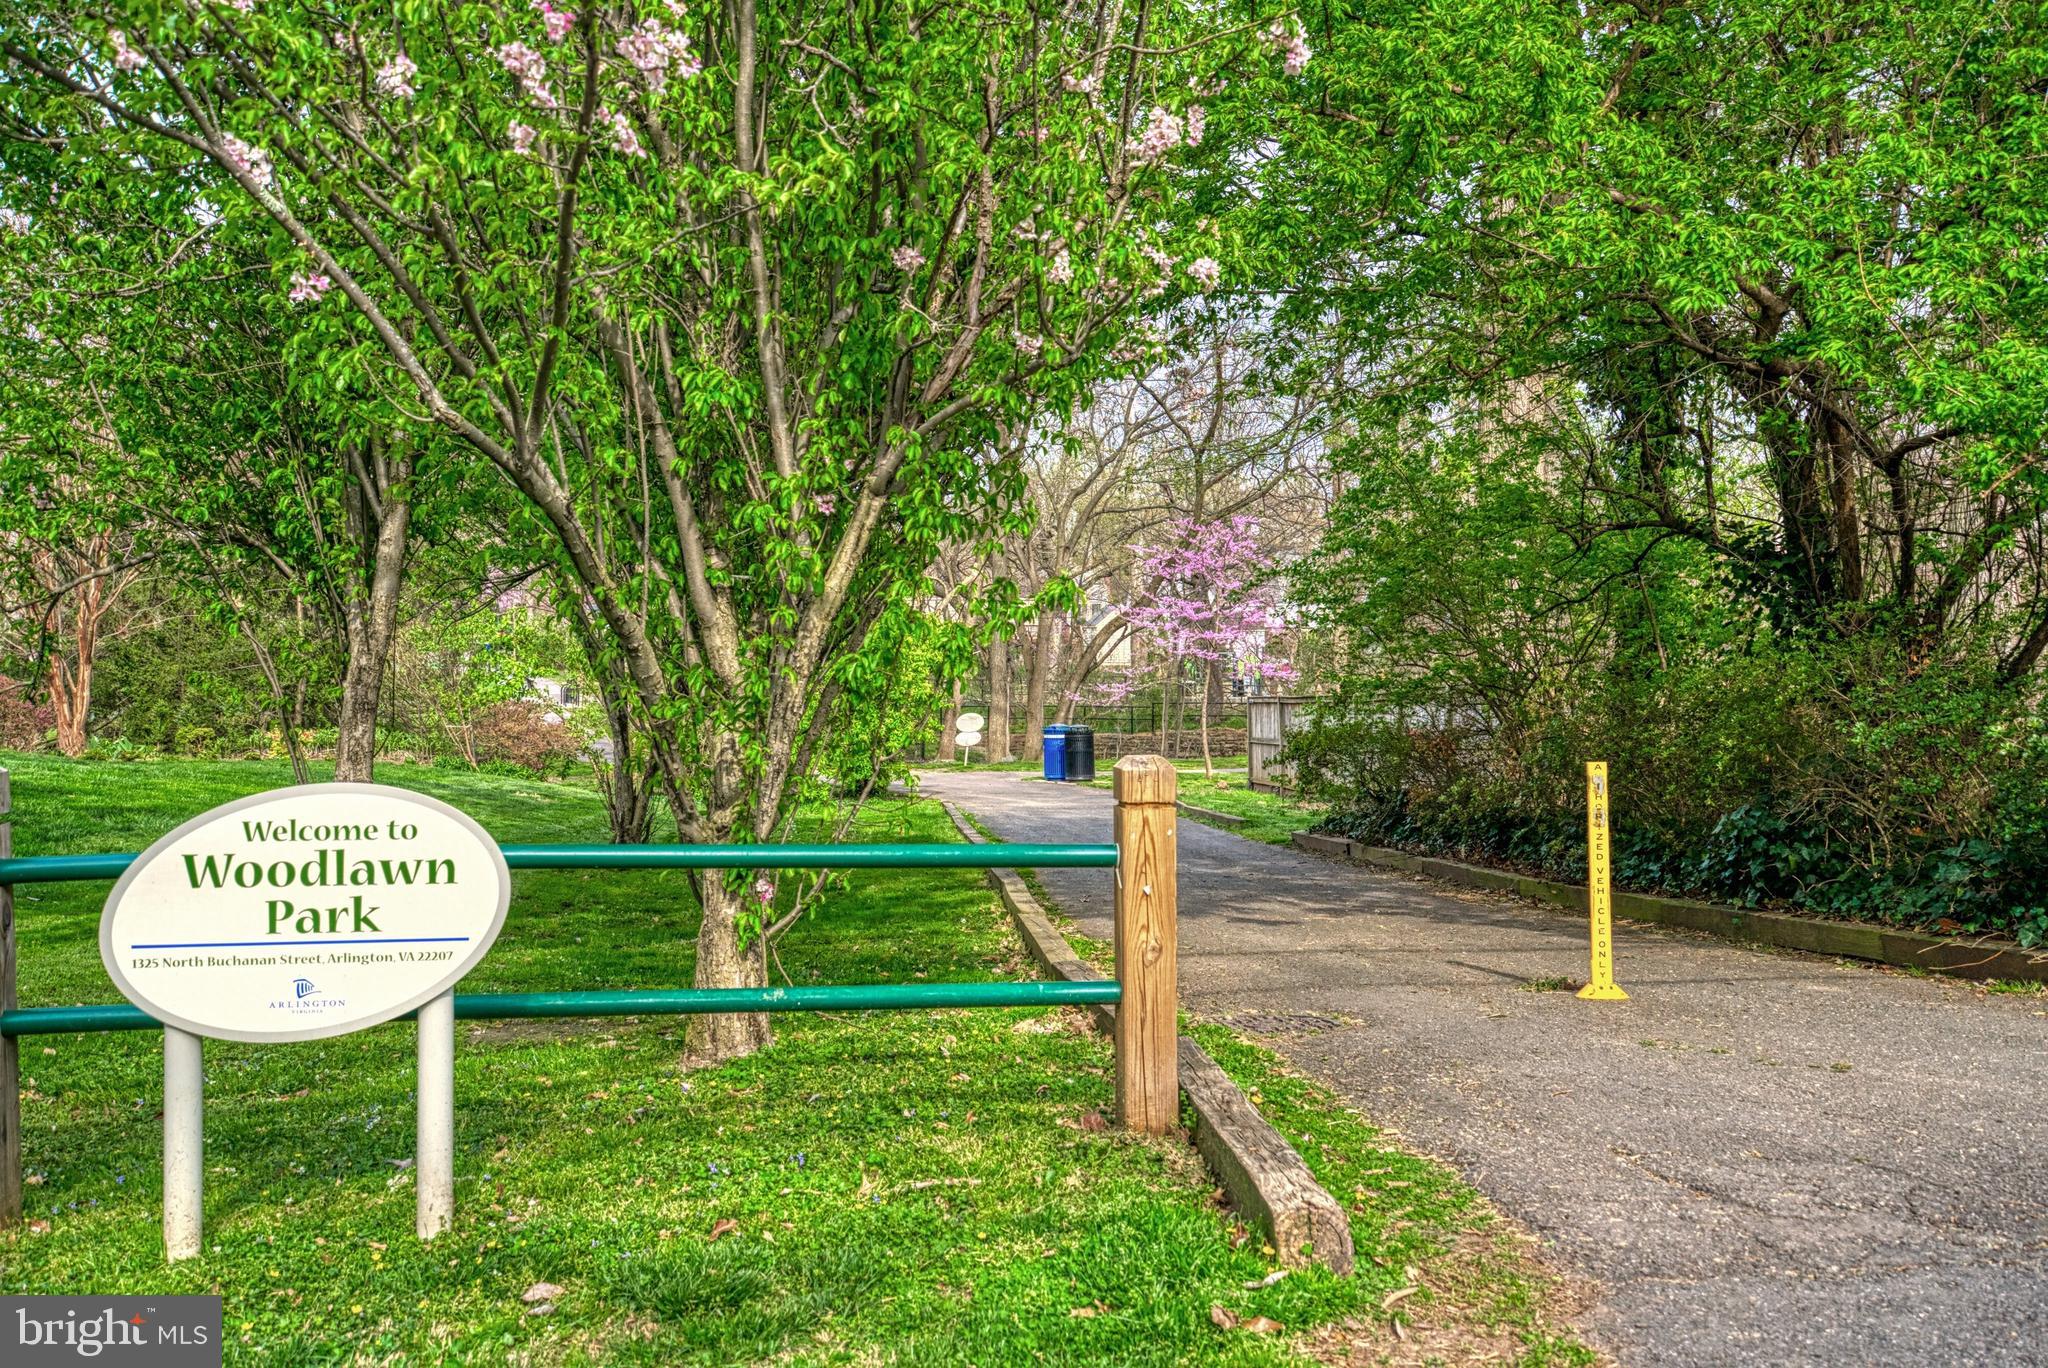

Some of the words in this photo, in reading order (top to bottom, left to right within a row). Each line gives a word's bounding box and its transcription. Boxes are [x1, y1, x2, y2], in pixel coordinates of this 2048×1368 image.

[242, 818, 378, 842] Welcome
[388, 820, 418, 841] to
[1594, 764, 1604, 861] AHORIZED
[182, 849, 458, 889] Woodlawn
[265, 896, 382, 935] Park
[1596, 867, 1605, 935] VEHICLE
[132, 958, 159, 969] 1325
[162, 955, 203, 968] North
[207, 954, 276, 967] Buchanan
[280, 953, 325, 965] Street,
[327, 952, 396, 965] Arlington,
[399, 951, 415, 962] VA
[418, 951, 454, 962] 22207
[1599, 940, 1607, 978] ONLY
[269, 999, 346, 1009] ARLINGTON
